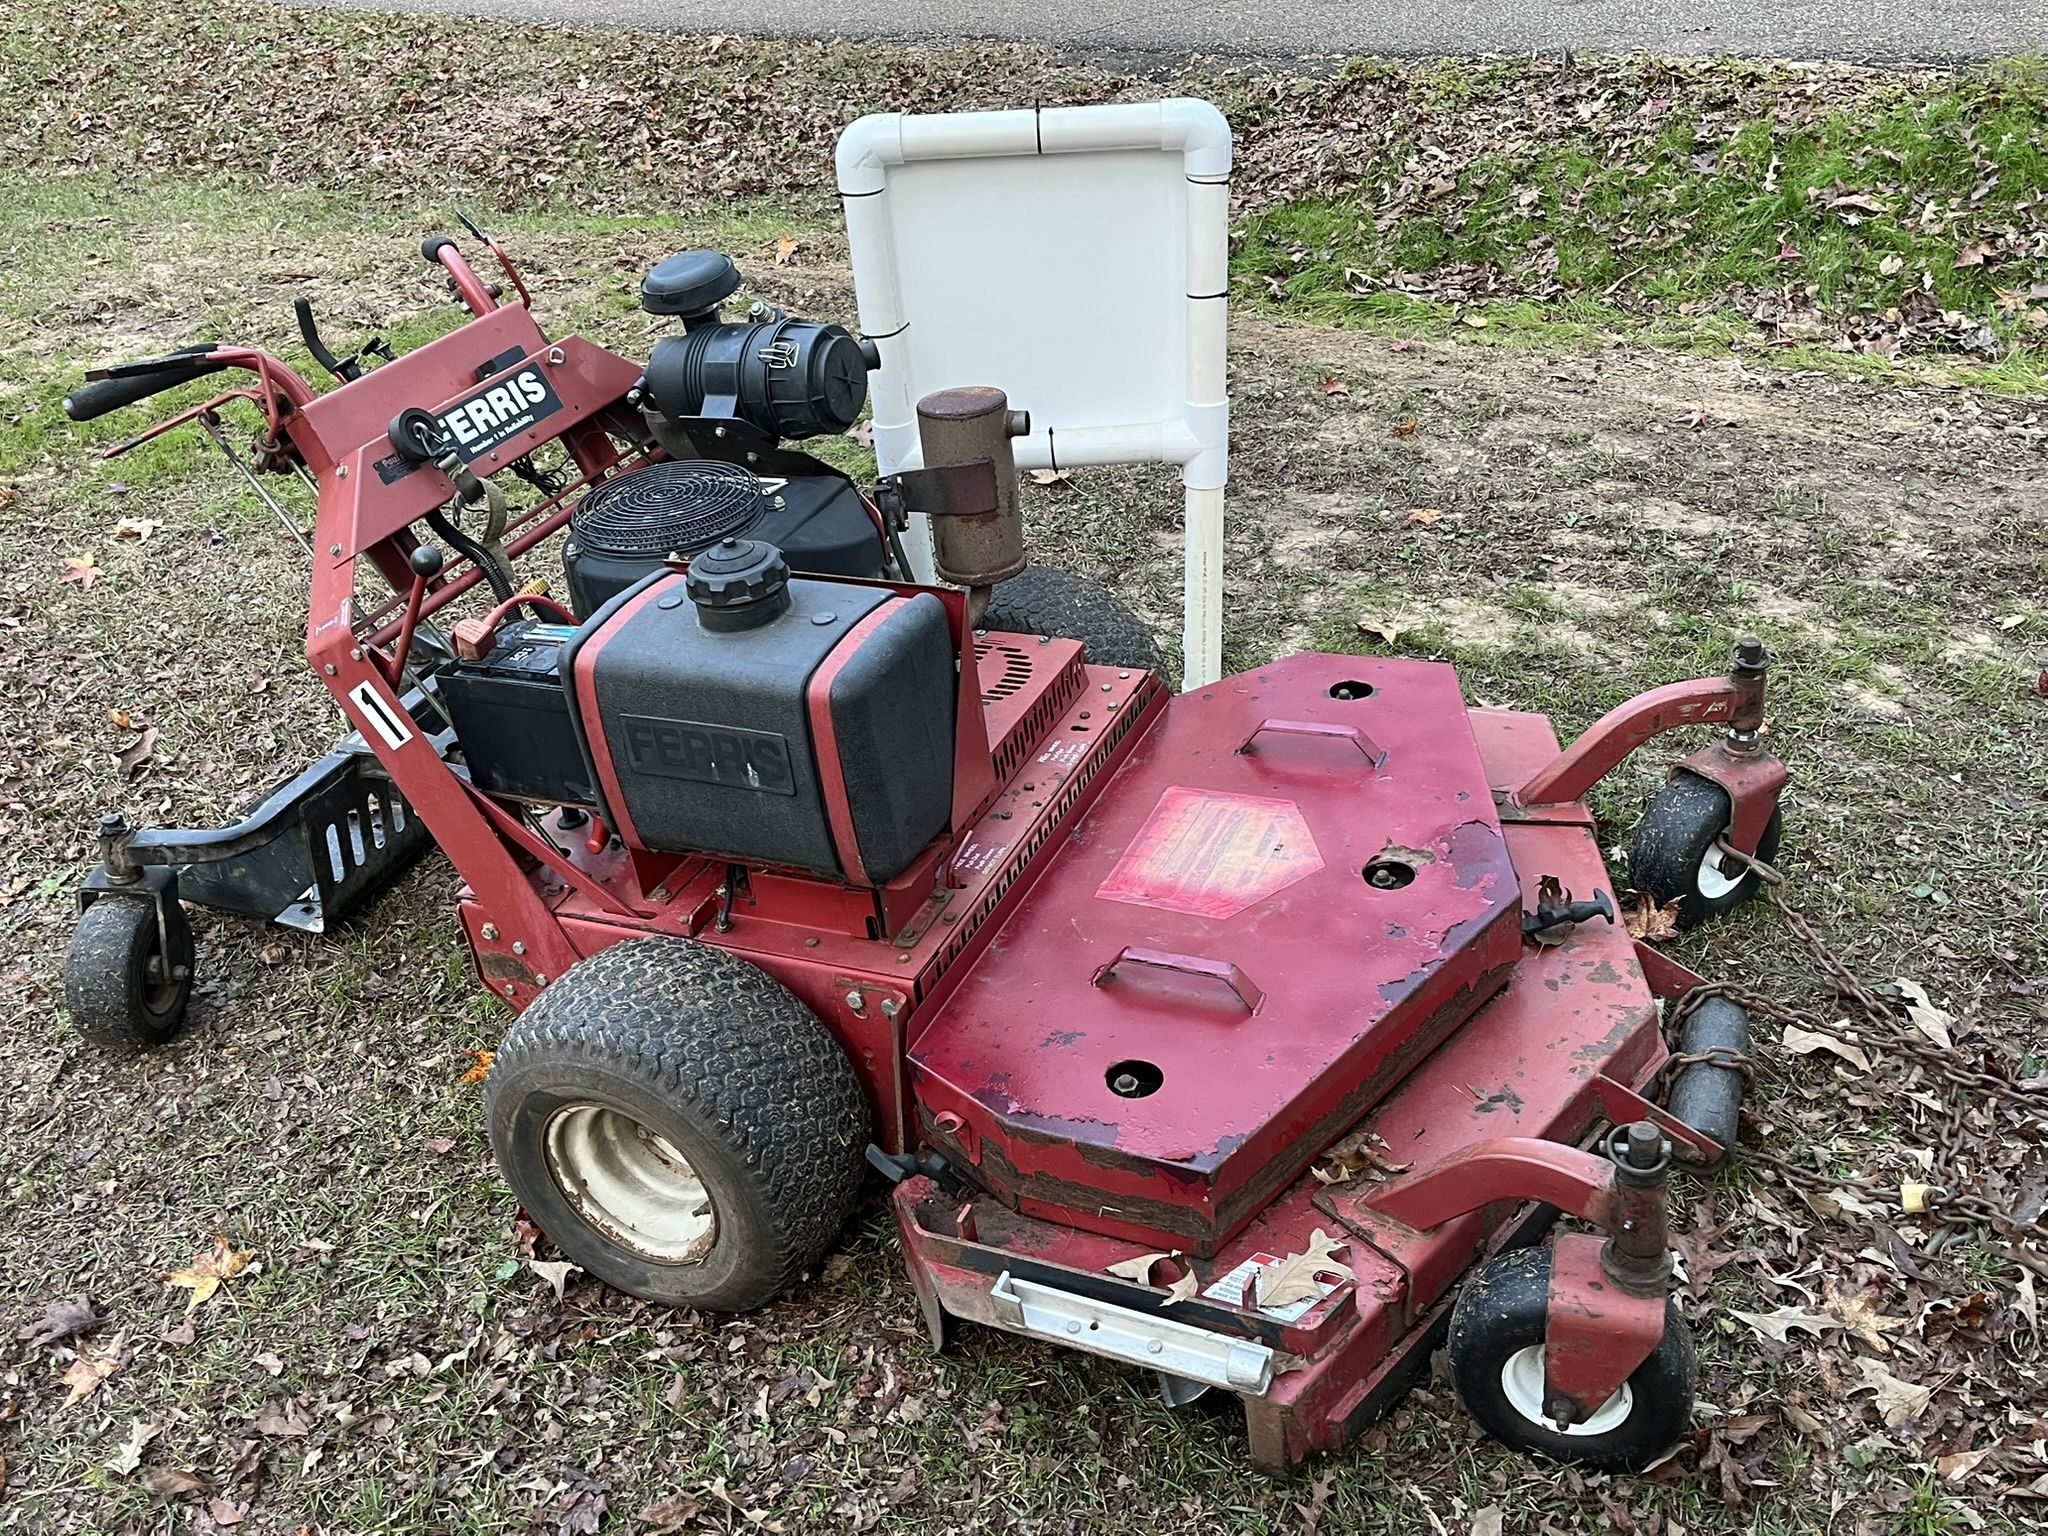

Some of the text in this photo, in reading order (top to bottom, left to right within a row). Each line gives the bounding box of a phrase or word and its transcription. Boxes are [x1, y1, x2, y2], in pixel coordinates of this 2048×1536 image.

[470, 437, 494, 454] Number
[504, 414, 535, 434] Reliability
[360, 687, 406, 742] 1
[626, 721, 786, 787] FERRIS
